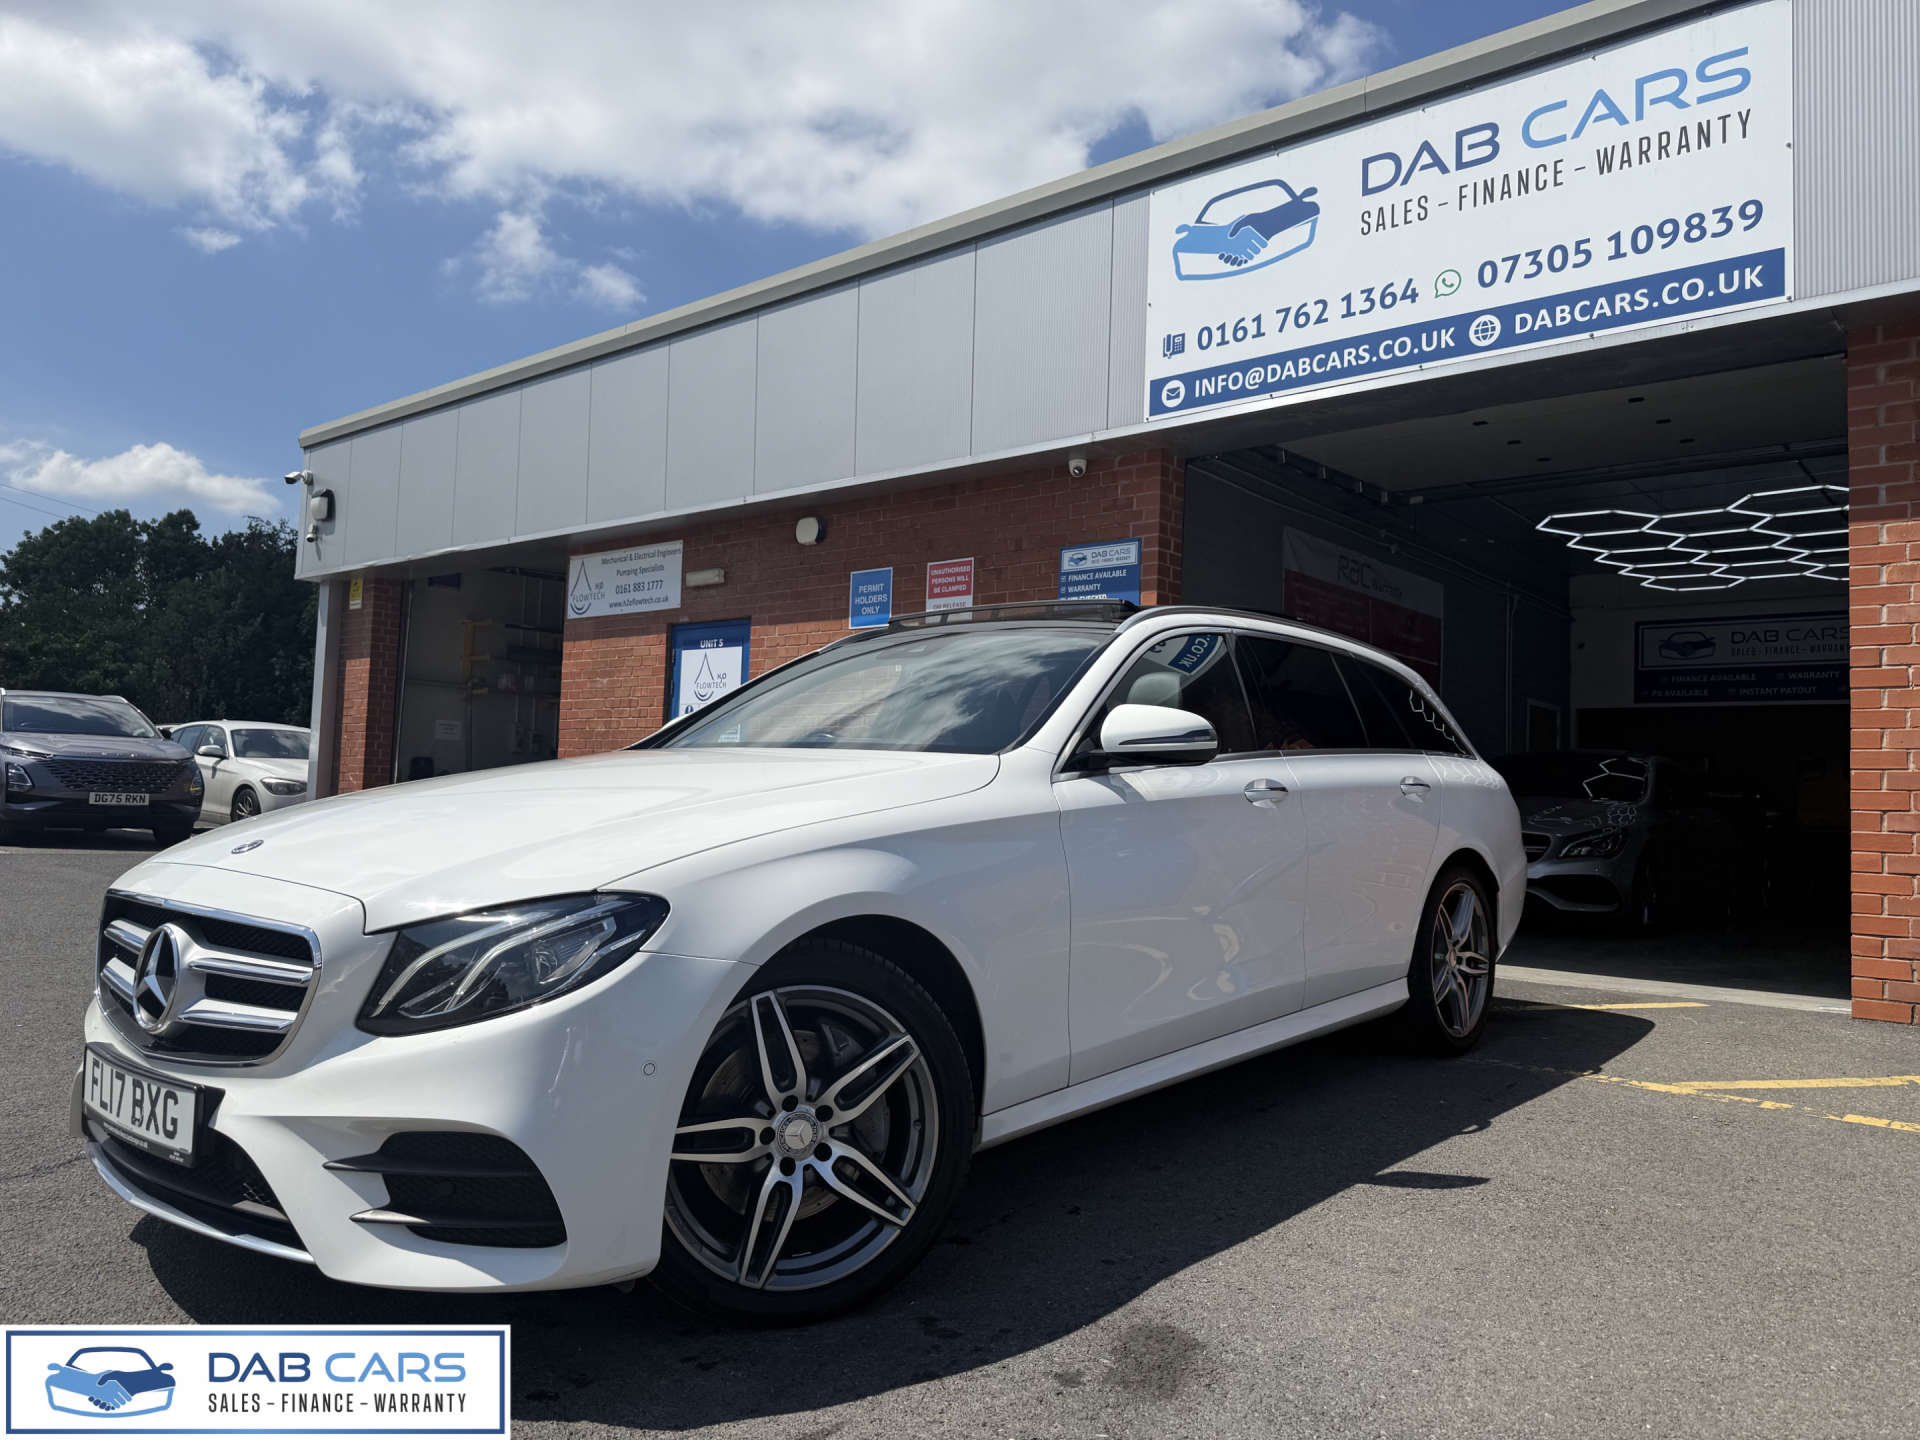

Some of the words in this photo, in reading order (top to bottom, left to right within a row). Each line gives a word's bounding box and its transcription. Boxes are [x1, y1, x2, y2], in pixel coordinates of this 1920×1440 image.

[1361, 122, 1500, 197] DAB
[1521, 46, 1751, 149] CARS
[1360, 195, 1429, 236] SALES
[1458, 158, 1564, 212] FINANCE
[1596, 108, 1751, 176] WARRANTY
[1477, 238, 1593, 289] 07305
[1607, 199, 1764, 261] 109839
[1514, 264, 1764, 335] DABCARS.CO.UK
[1197, 313, 1266, 351] 0161
[1275, 298, 1329, 333] 762
[1340, 278, 1419, 318] 1364
[1194, 327, 1456, 398] INFO@DABCARS.CO.UK
[1091, 551, 1107, 559] DAB
[1068, 572, 1094, 582] FINANCE
[1094, 569, 1127, 579] AVAILABLE
[615, 583, 631, 595] 0161
[632, 581, 645, 593] 883
[647, 580, 663, 591] 1777
[858, 583, 884, 594] PERMIT
[1068, 583, 1101, 593] WARRANTY
[855, 593, 888, 605] HOLDERS
[861, 606, 880, 615] ONLY
[1731, 630, 1779, 643] DAB
[700, 640, 717, 649] UNIT
[718, 639, 724, 647] 5
[696, 681, 727, 690] FLOWTECH
[94, 794, 122, 803] DG75
[126, 794, 146, 804] RKN
[91, 1057, 126, 1118] FL17
[131, 1078, 179, 1140] BXG
